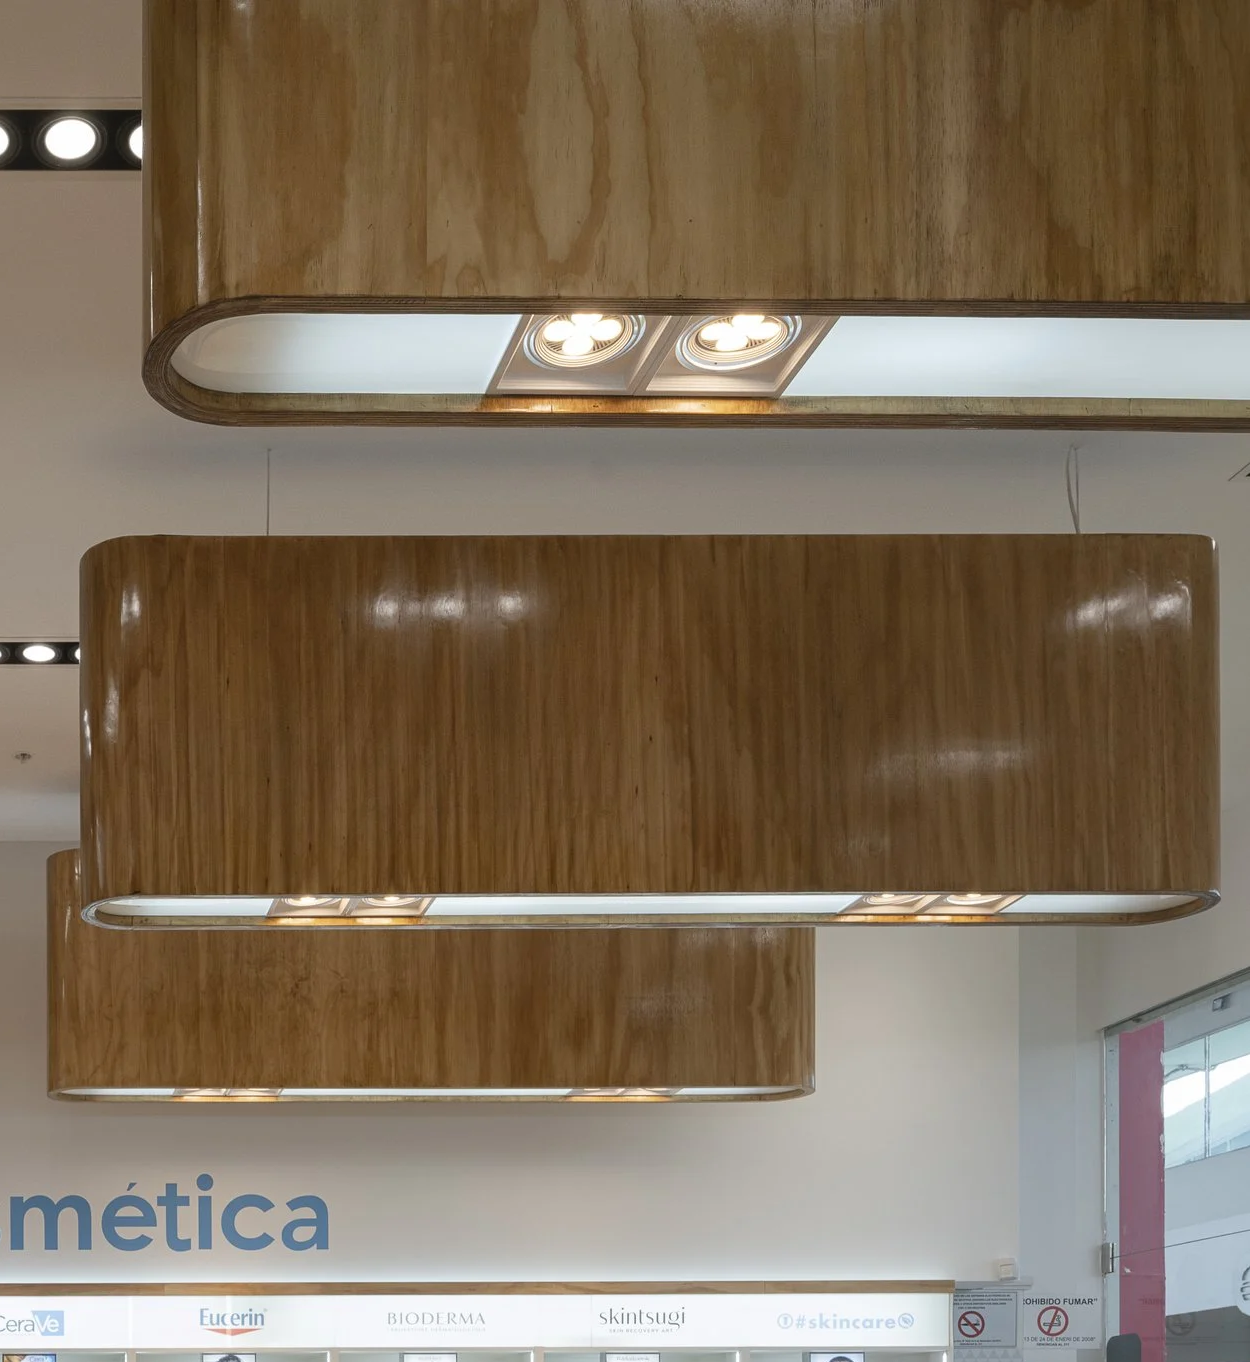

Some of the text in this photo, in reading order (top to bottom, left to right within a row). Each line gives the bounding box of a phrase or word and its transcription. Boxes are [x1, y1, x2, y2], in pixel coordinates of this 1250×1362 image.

[200, 1308, 265, 1326] Eucerin
[388, 1312, 485, 1325] BIODERMA
[599, 1307, 686, 1328] skintsugi
